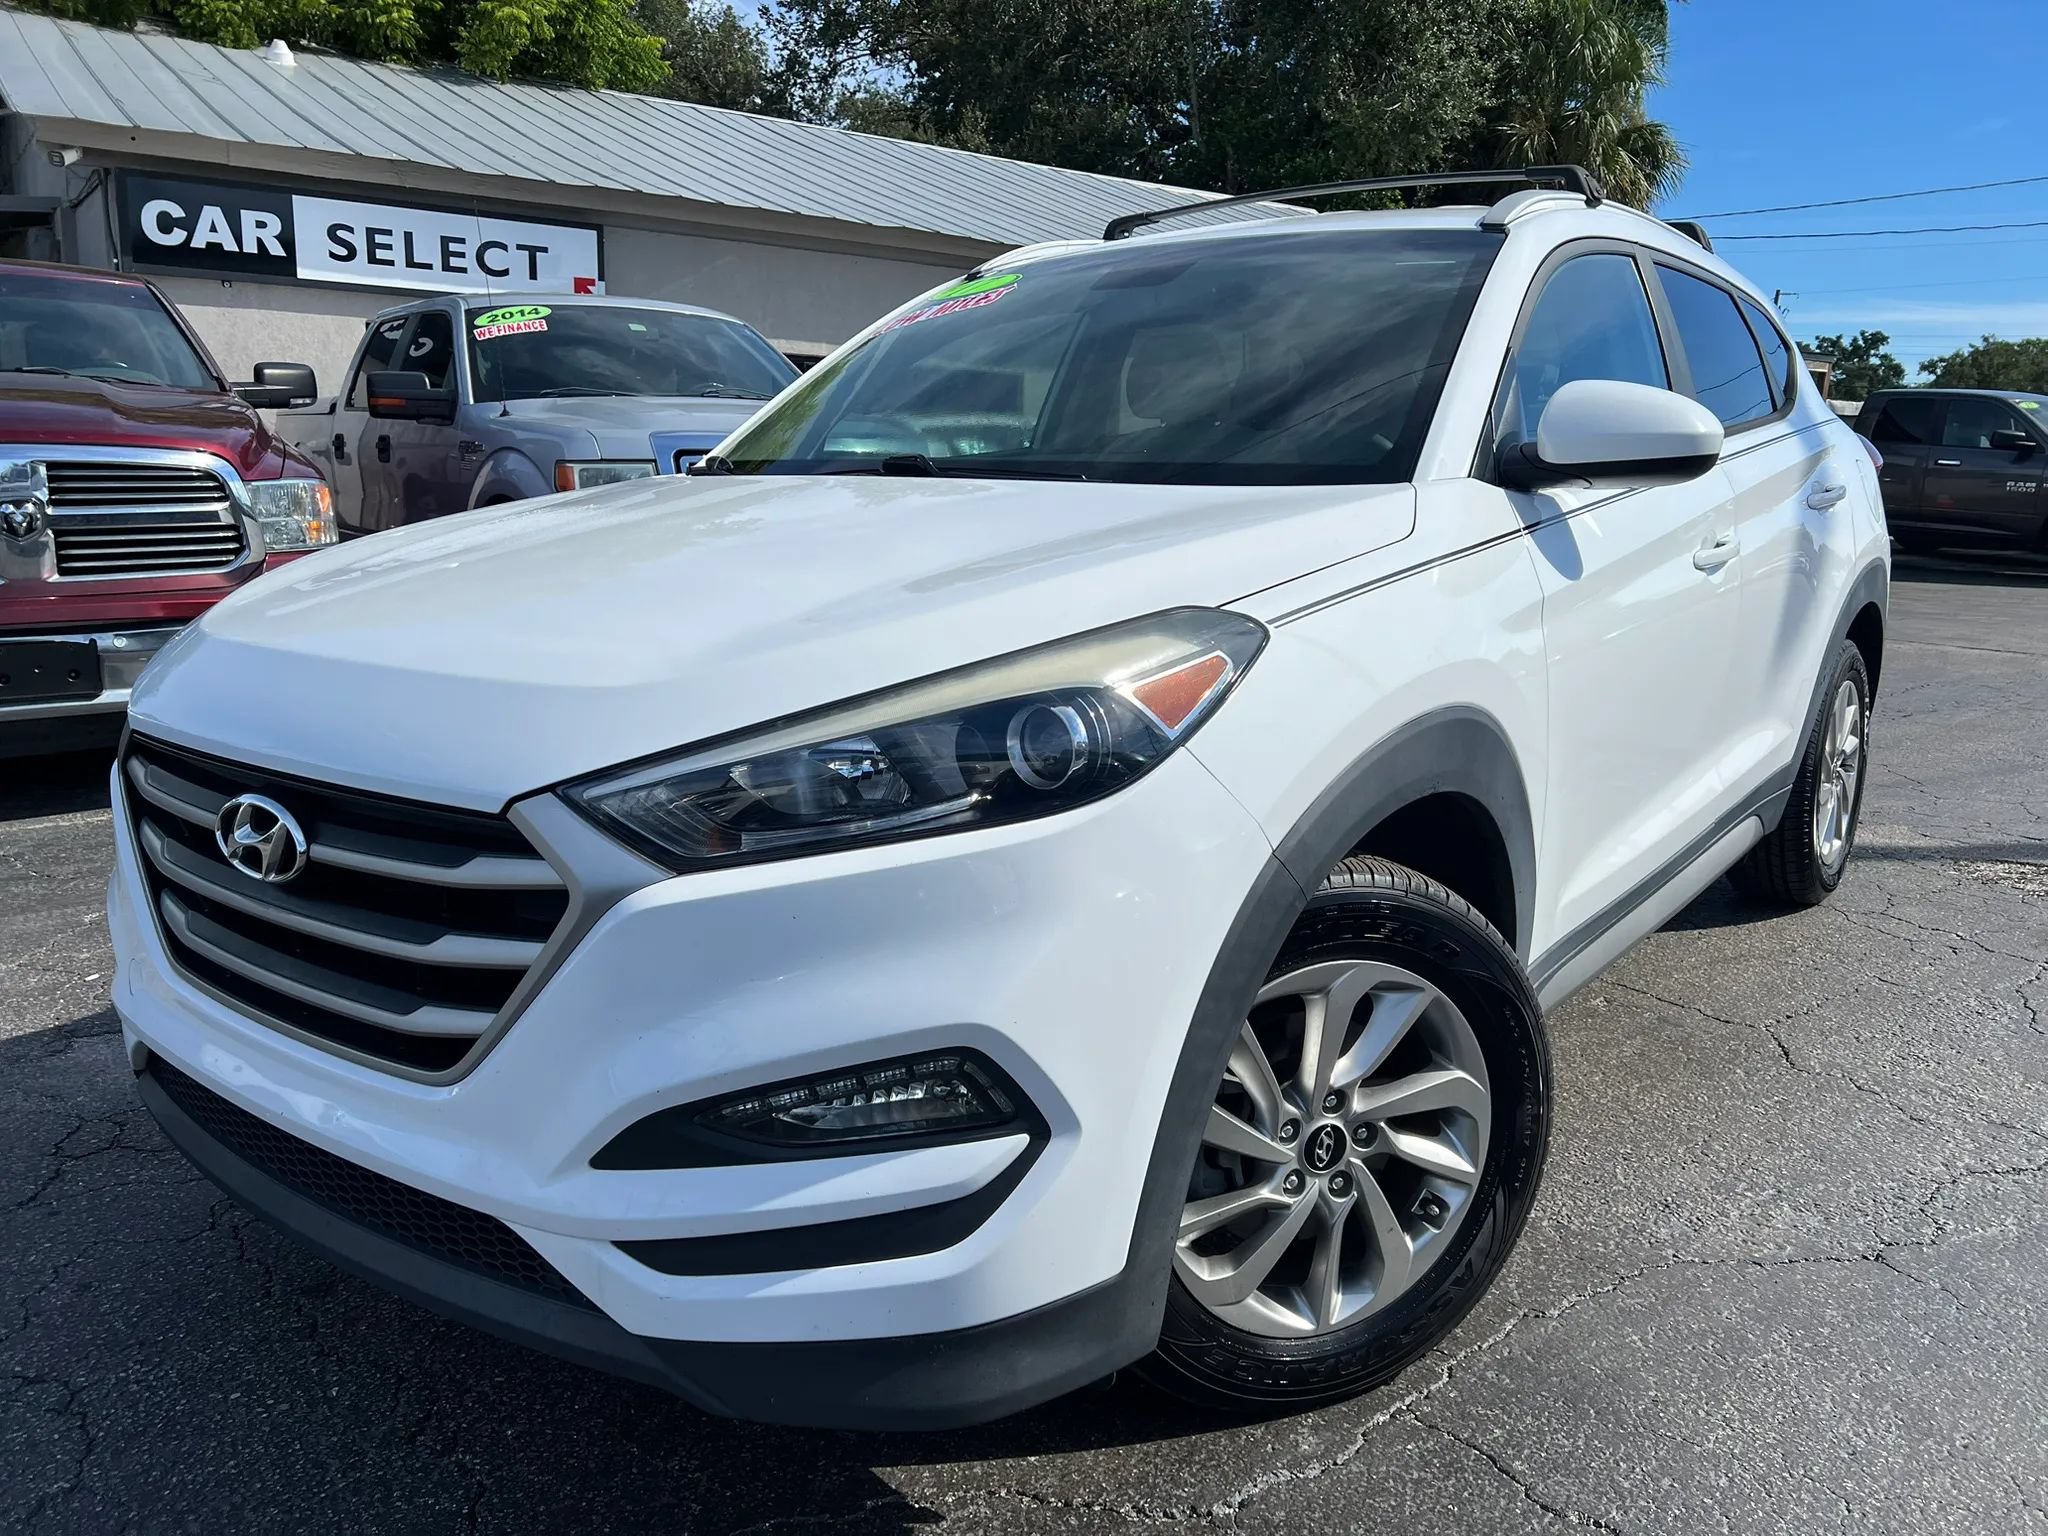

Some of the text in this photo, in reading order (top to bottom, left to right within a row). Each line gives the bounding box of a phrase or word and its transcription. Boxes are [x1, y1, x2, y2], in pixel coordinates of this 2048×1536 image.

[140, 199, 549, 281] CAR SELECT
[486, 307, 542, 324] 2014
[475, 320, 546, 339] WE FINANCE
